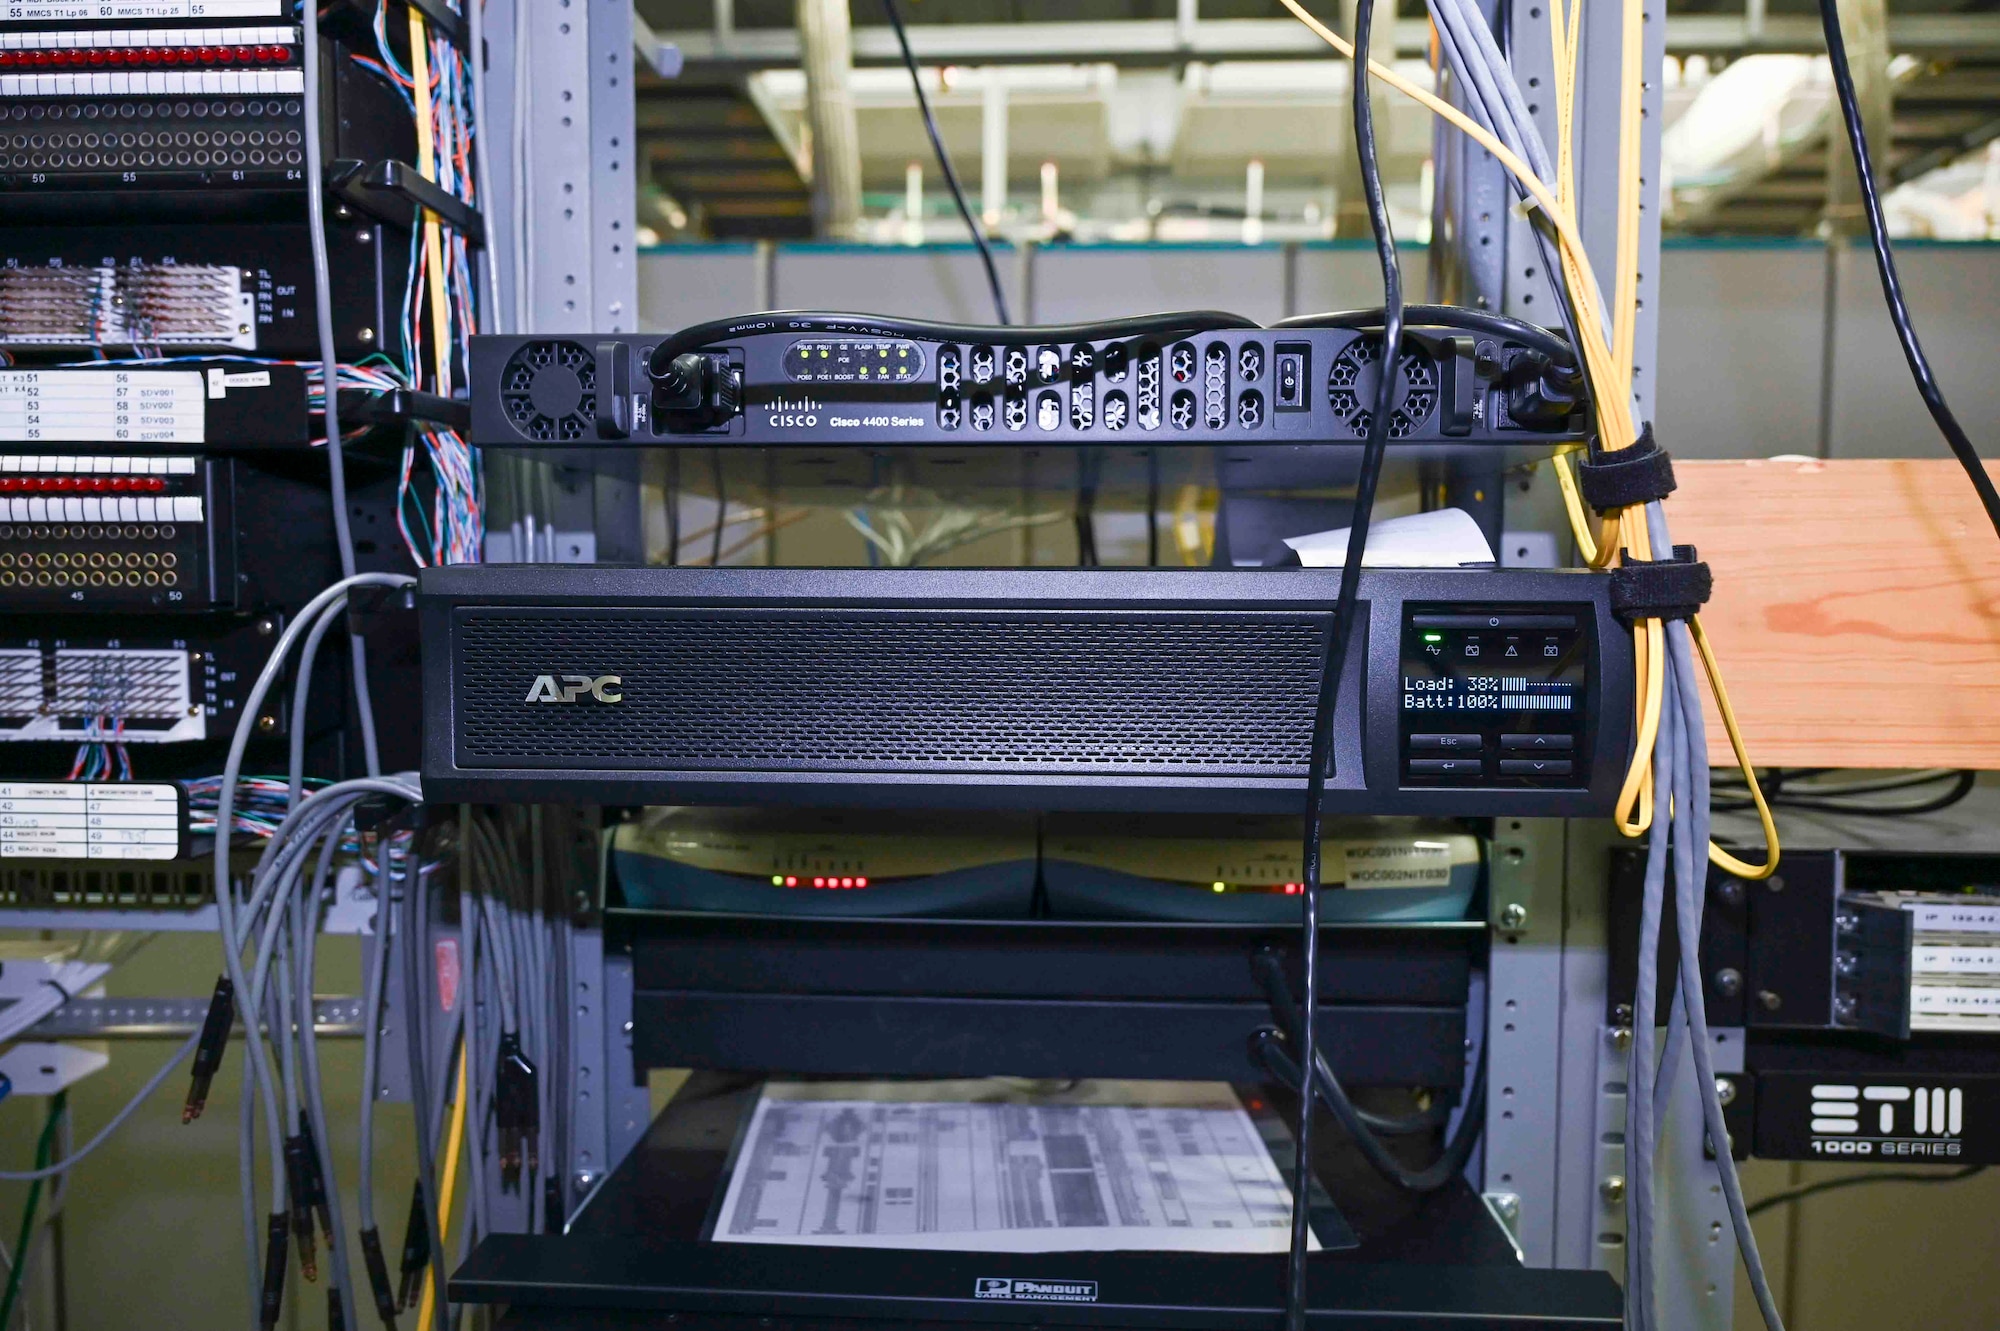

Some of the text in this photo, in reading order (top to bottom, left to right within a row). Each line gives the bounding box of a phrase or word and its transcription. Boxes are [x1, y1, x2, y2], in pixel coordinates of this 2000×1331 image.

[10, 9, 22, 17] 55
[100, 7, 112, 16] 60
[170, 7, 179, 15] 25
[192, 5, 204, 14] 65
[32, 171, 301, 183] 50 55 61 64
[276, 285, 296, 296] OUT
[27, 374, 38, 382] 51
[116, 374, 128, 383] 56
[27, 388, 39, 396] 52
[116, 388, 128, 396] 57
[27, 401, 39, 410] 53
[116, 402, 128, 410] 58
[28, 415, 40, 424] 54
[116, 415, 129, 424] 59
[770, 415, 817, 427] CISCO
[830, 416, 924, 427] Cisco 4400 Series
[28, 429, 40, 438] 55
[116, 430, 129, 438] 60
[71, 591, 182, 600] 45 50
[1404, 677, 1498, 691] Load: 38%
[525, 675, 622, 703] APC
[1440, 737, 1457, 745] Esc
[2, 802, 13, 810] 42
[90, 803, 100, 811] 47
[3, 816, 14, 825] 43
[90, 818, 102, 826] 48
[3, 831, 14, 839] 44
[91, 832, 102, 840] 49
[3, 845, 15, 854] 45
[91, 846, 102, 855] 50
[1811, 1141, 1961, 1156] 1000 SERIES
[1015, 1282, 1092, 1294] PANDUIT
[1016, 1294, 1097, 1302] MANAGEMENT
